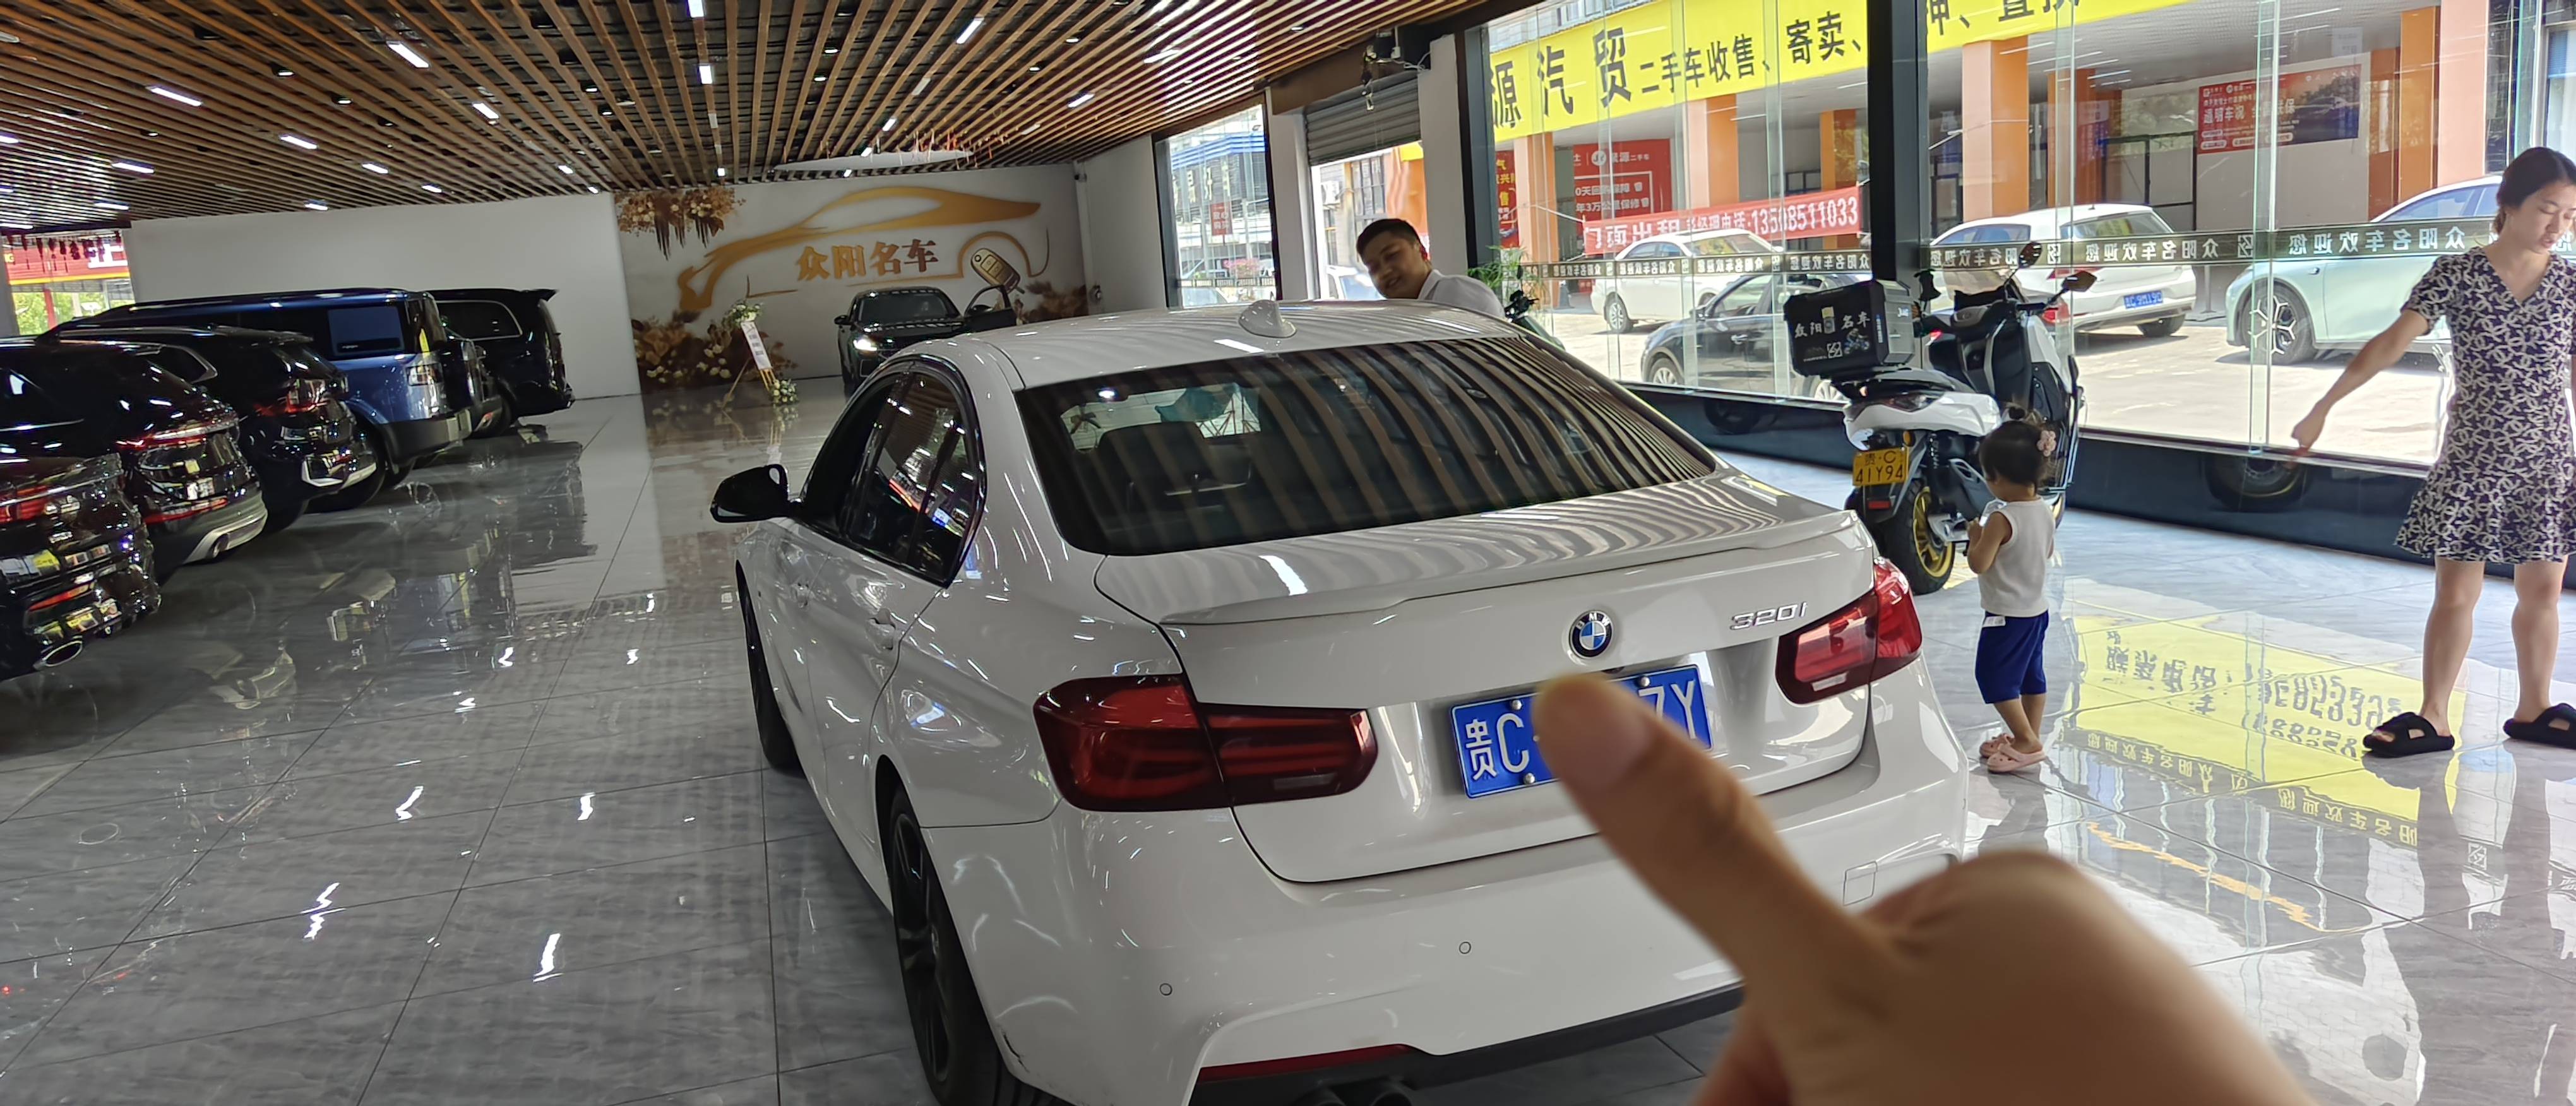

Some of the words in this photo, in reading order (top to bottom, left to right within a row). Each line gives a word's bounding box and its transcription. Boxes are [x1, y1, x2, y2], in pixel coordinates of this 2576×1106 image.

[1585, 218, 1681, 249] 门面出租
[796, 239, 939, 281] 众阳名车
[1794, 322, 1822, 339] 众阳
[1841, 311, 1871, 330] 名车
[1856, 464, 1904, 484] 41Y94
[1576, 612, 1611, 630] BMW
[1730, 601, 1808, 631] 320i
